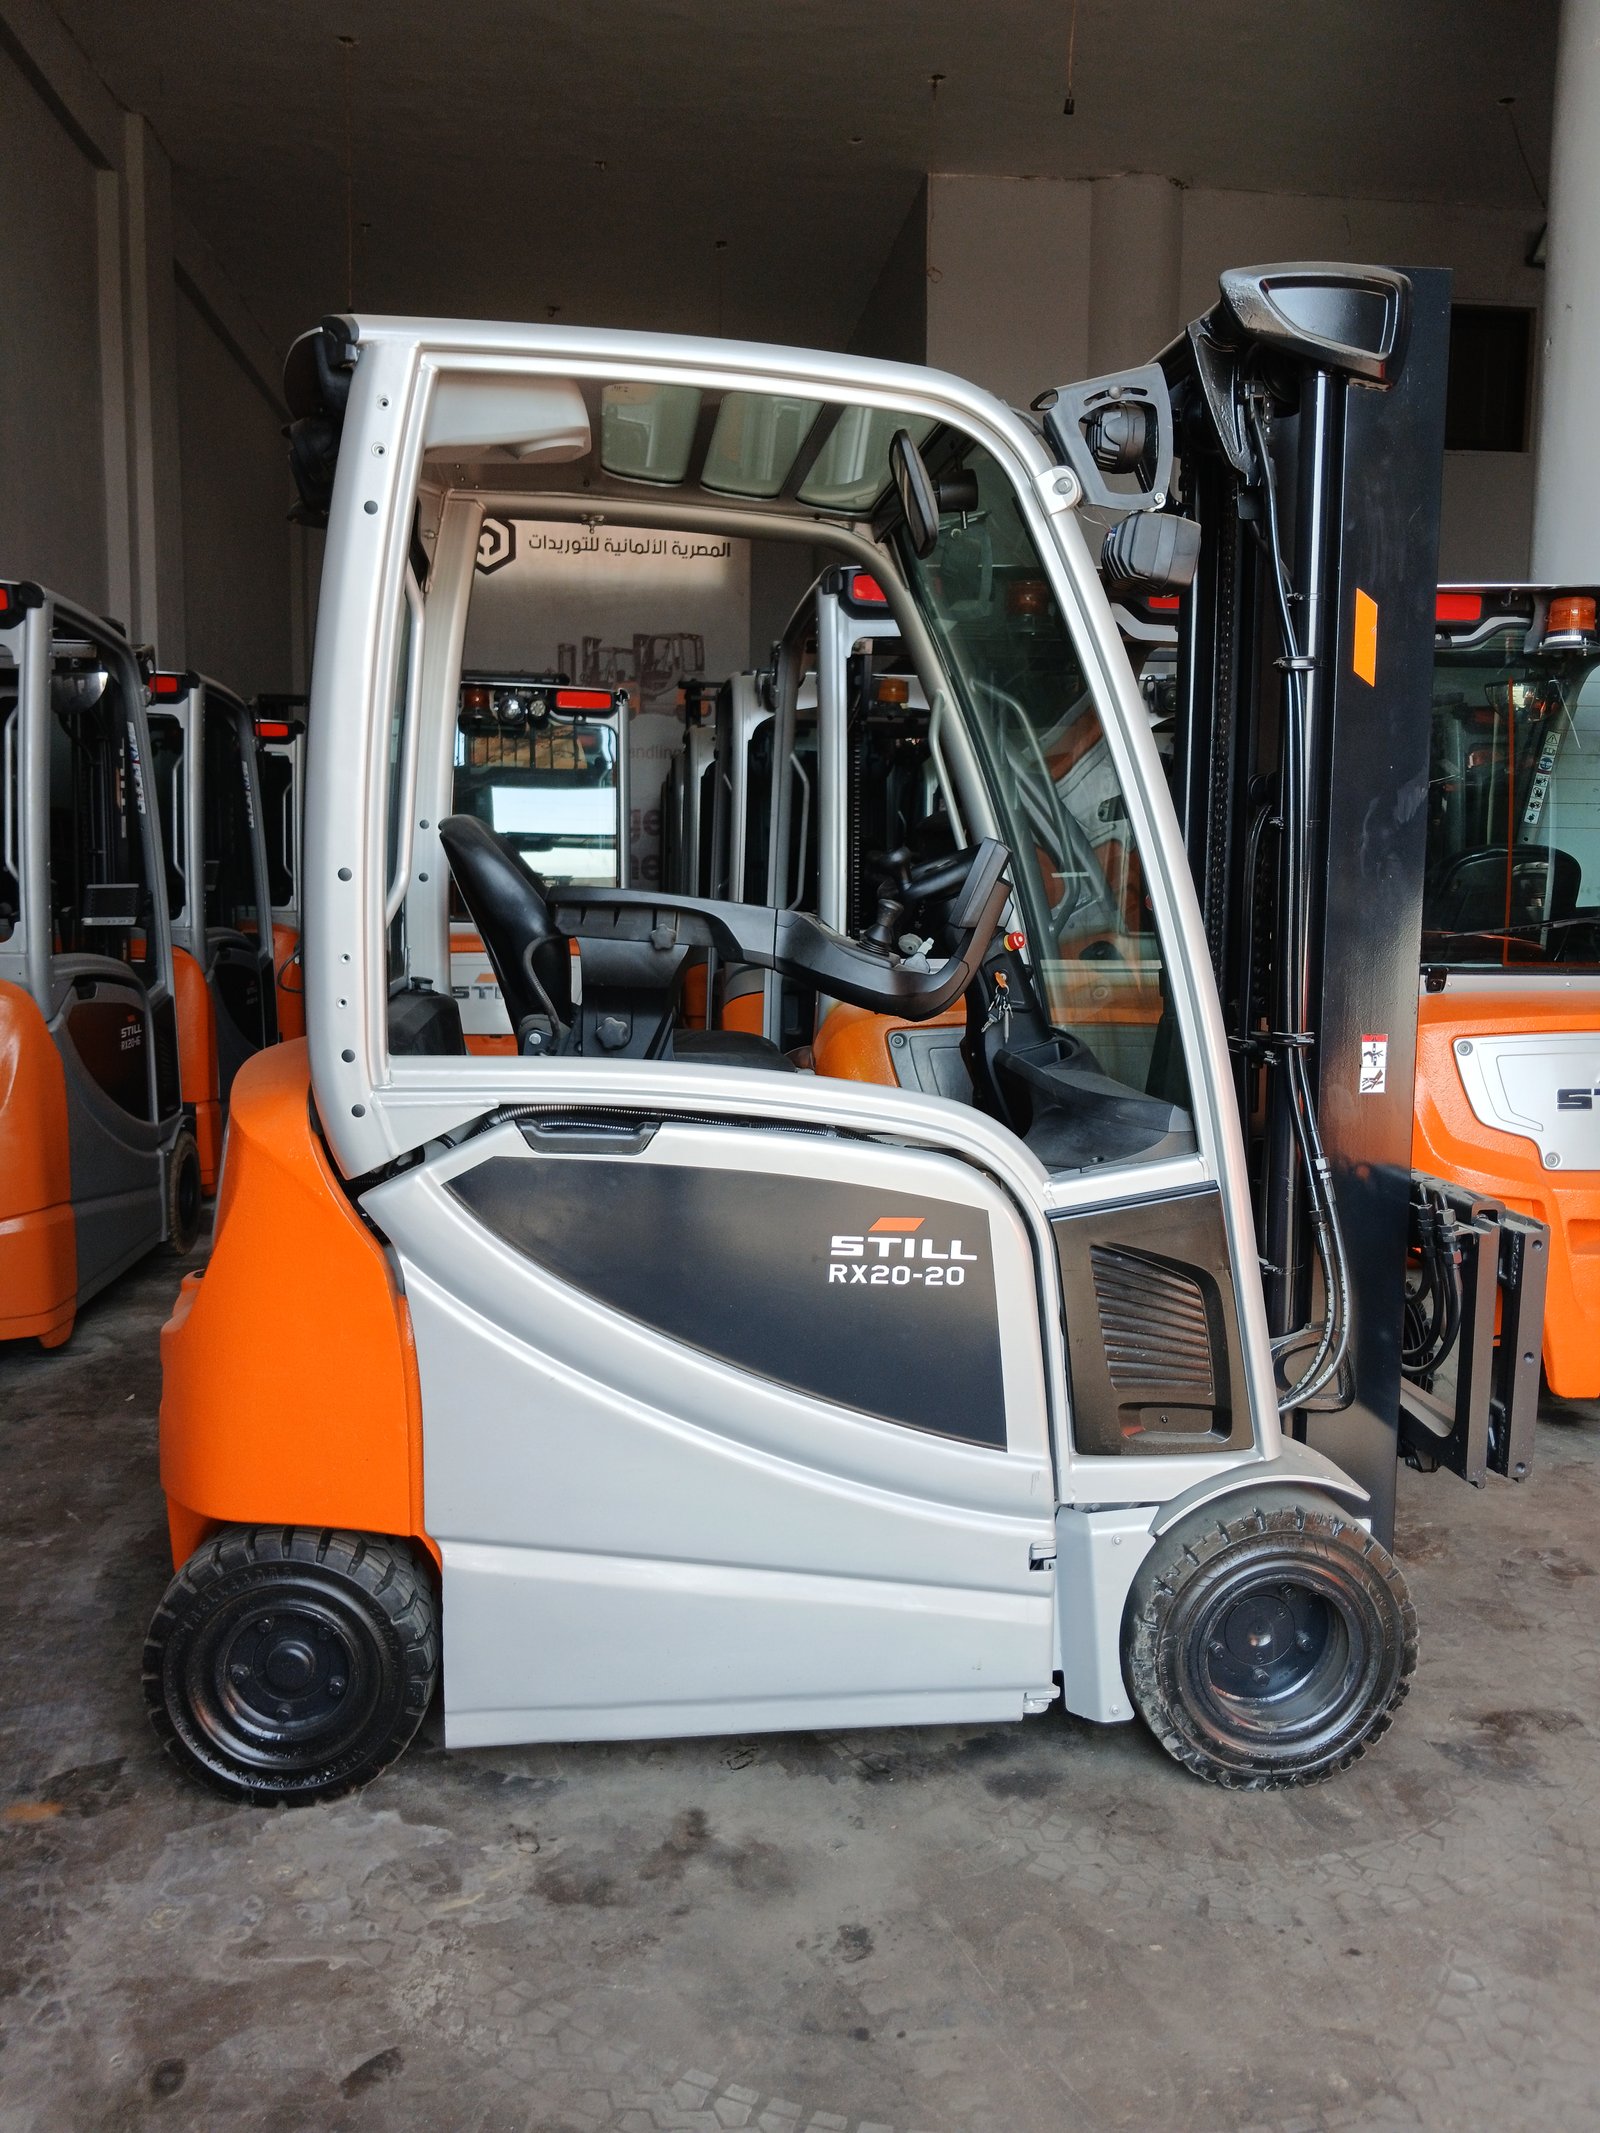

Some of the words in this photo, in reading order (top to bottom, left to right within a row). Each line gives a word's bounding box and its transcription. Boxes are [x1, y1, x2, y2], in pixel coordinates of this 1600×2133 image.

[528, 533, 600, 555] للتوريدات
[604, 537, 667, 557] الألمانية
[671, 541, 731, 560] المصرية
[451, 985, 504, 1000] STI
[121, 1024, 142, 1039] STILL
[830, 1235, 978, 1261] STILL
[828, 1263, 965, 1286] RX20-20
